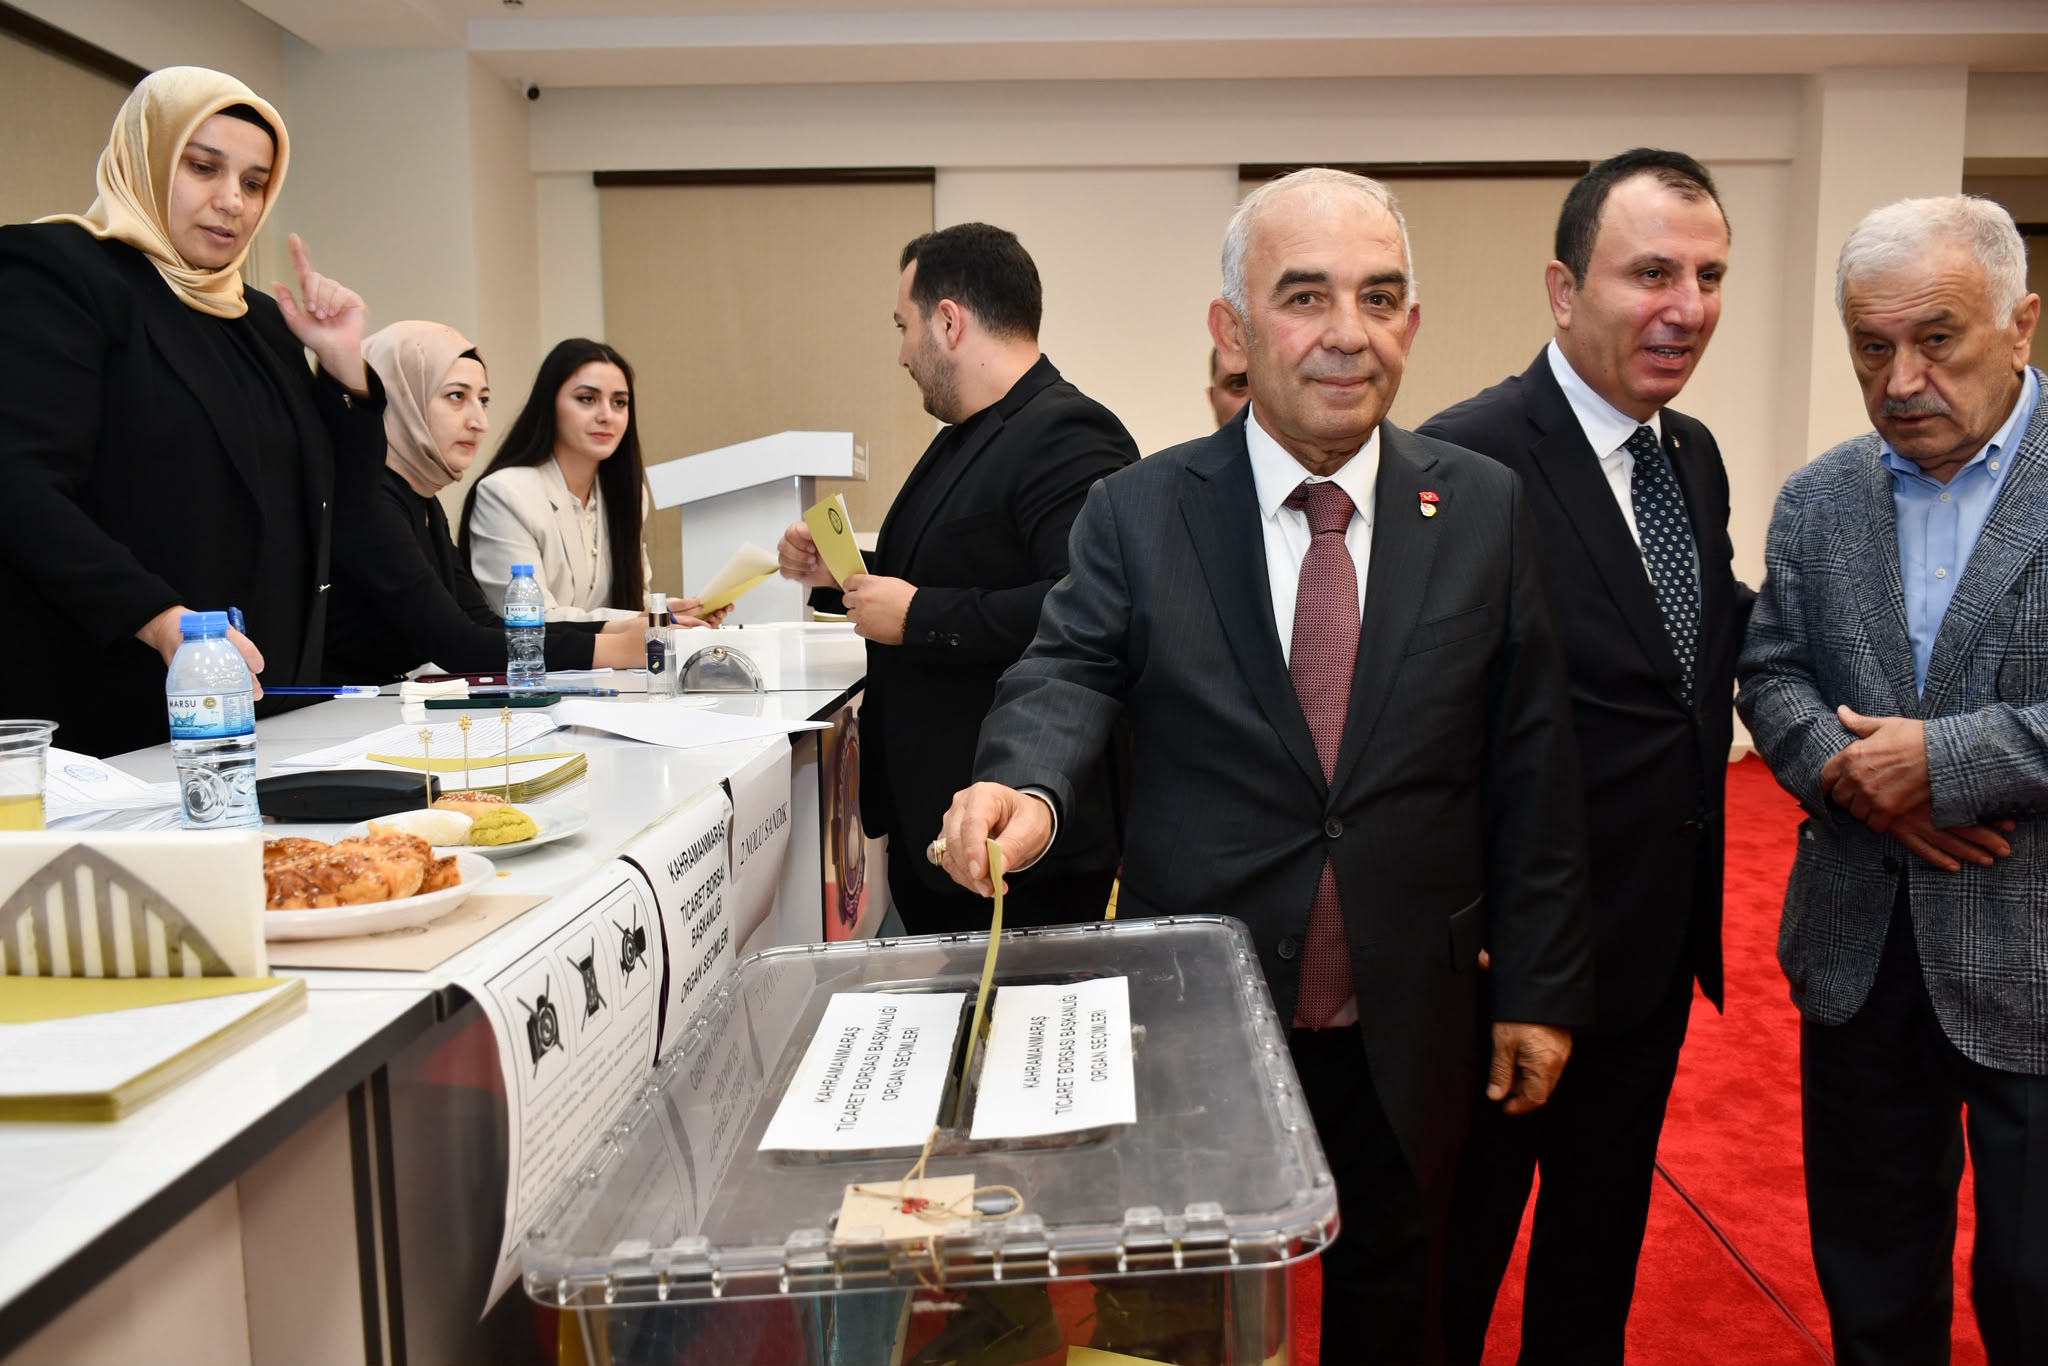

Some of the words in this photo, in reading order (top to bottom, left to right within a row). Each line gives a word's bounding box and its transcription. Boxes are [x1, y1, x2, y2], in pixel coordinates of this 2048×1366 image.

[168, 699, 197, 709] MARSU
[740, 841, 745, 866] 2
[745, 823, 764, 861] NOLU
[764, 801, 787, 840] SANDIK
[680, 884, 706, 927] TİCARET
[691, 892, 722, 949] BAŞKANLIĞI
[681, 959, 702, 1004] ORGAN
[703, 920, 729, 975] SEÇİMLERİ
[867, 1006, 898, 1052] BAŞKANLIĞI
[1058, 993, 1080, 1037] BAŞKANLIĞI
[1088, 1009, 1111, 1050] SEÇİMLERİ
[813, 1026, 864, 1103] KAHRAMANMARAŞ
[893, 1026, 920, 1068] SEÇİMLERİ
[1023, 1015, 1050, 1089] KAHRAMANMARAŞ
[1058, 1037, 1076, 1075] BORSASI
[1090, 1051, 1107, 1082] ORGAN
[853, 1053, 882, 1090] BORSASI
[882, 1069, 906, 1102] ORGAN
[834, 1093, 866, 1132] TİCARET
[1051, 1077, 1074, 1115] TİCARET
